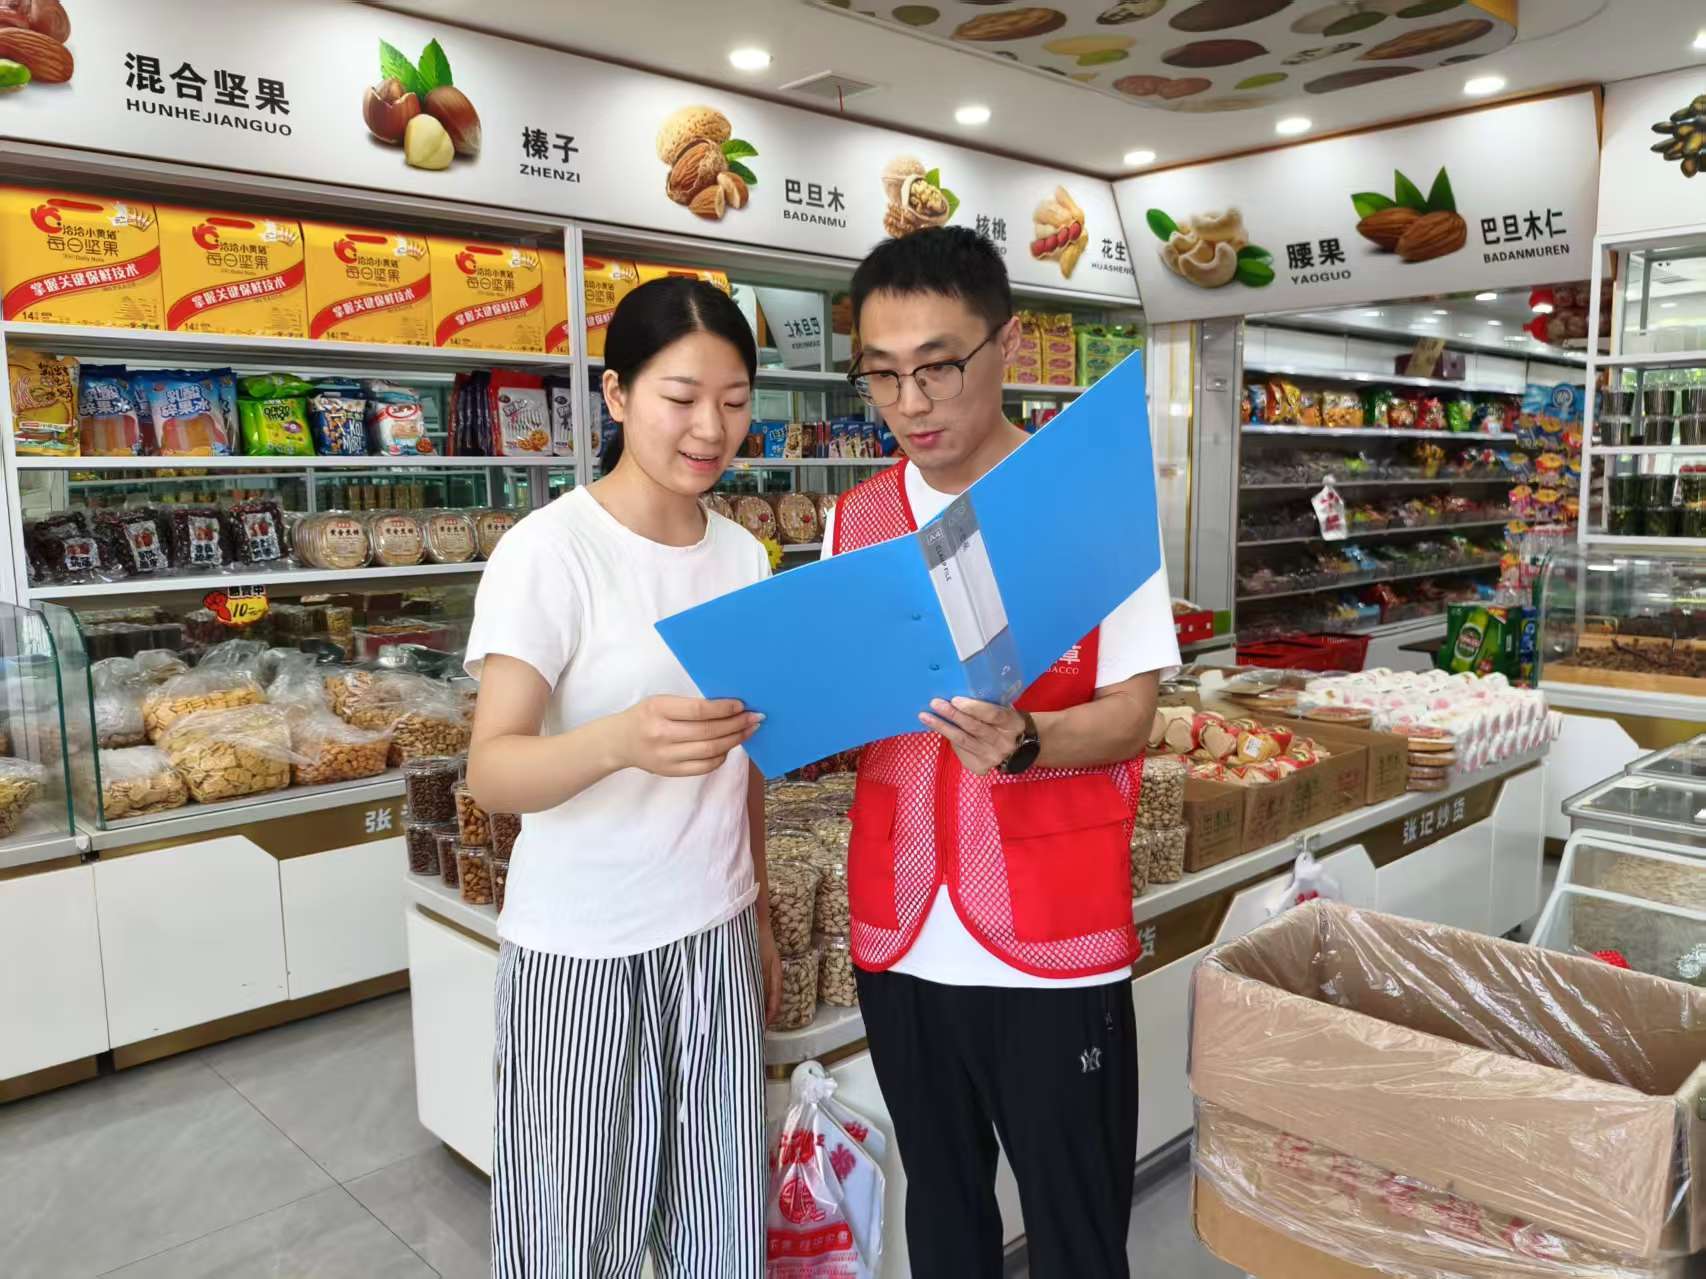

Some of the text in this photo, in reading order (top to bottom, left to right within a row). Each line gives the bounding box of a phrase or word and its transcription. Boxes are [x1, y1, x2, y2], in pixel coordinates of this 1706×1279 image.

[124, 52, 290, 115] 混合坚果
[126, 98, 292, 136] HUNHEJIANGUO
[522, 126, 579, 164] 榛子
[519, 163, 581, 183] ZHENZI
[785, 179, 846, 213] 巴旦木
[783, 210, 847, 228] BADANMU
[975, 214, 1007, 242] 核桃
[1480, 208, 1567, 246] 巴旦木仁
[47, 234, 120, 257] 每日坚果
[1101, 238, 1127, 262] 花生
[1286, 238, 1346, 271] 腰果
[1483, 243, 1570, 264] BADANMUREN
[30, 263, 140, 296] 掌握关键保鲜技术
[1290, 269, 1352, 285] YAOGUO
[929, 527, 944, 544] A4
